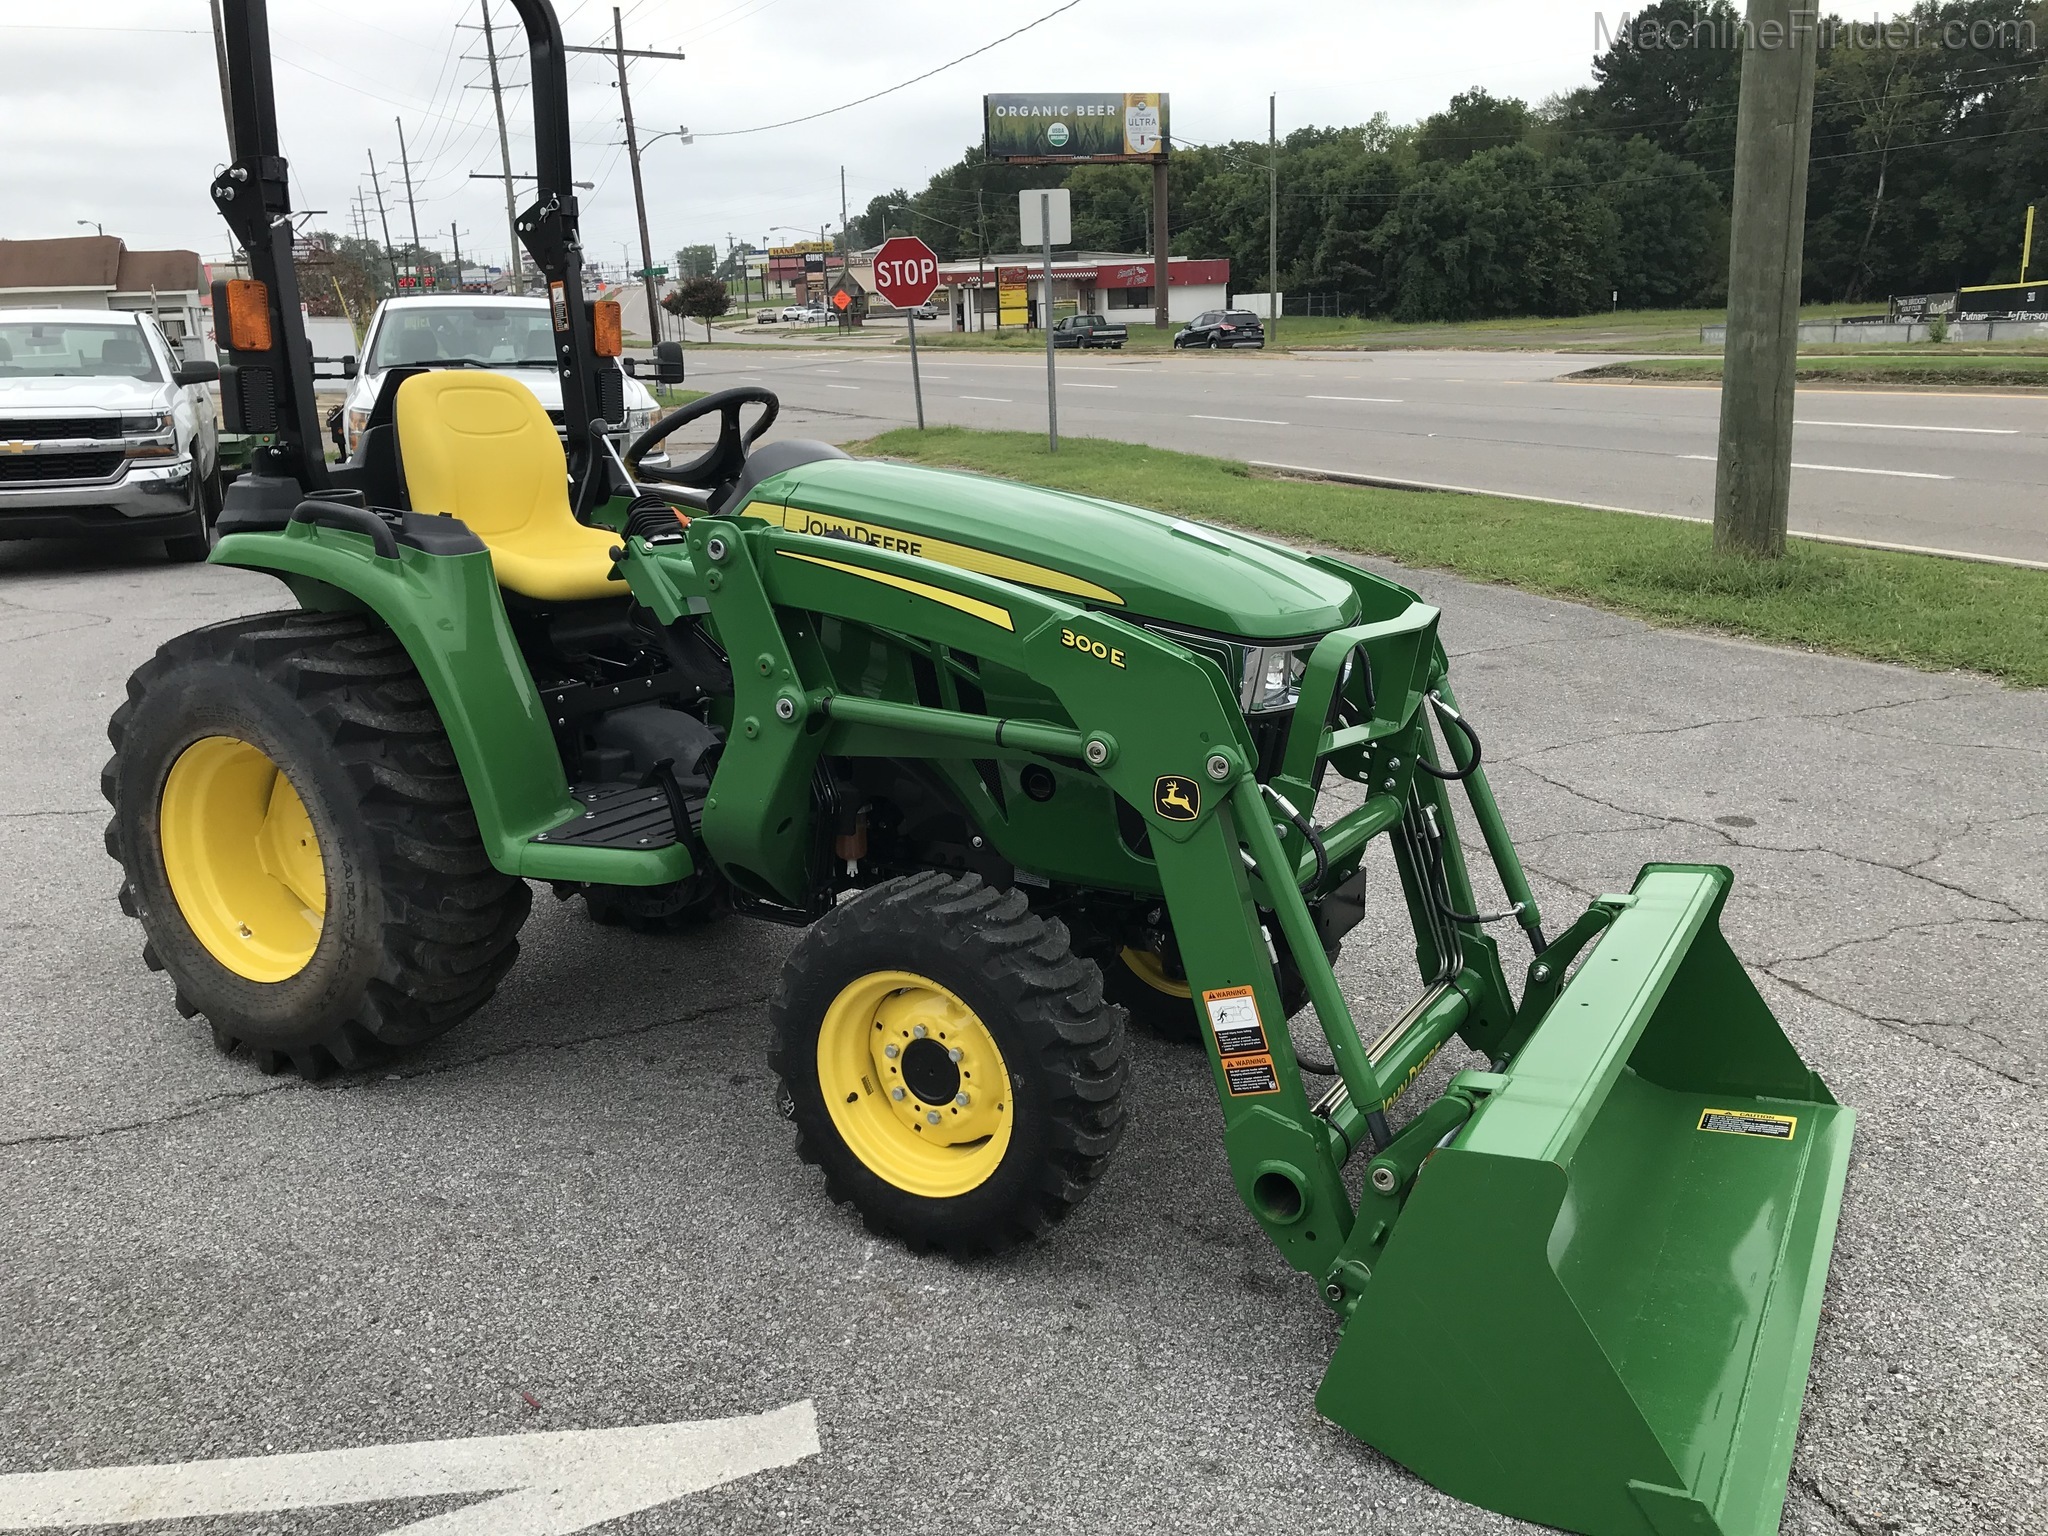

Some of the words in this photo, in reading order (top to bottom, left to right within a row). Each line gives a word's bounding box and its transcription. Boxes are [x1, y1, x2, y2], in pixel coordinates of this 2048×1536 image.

[996, 105, 1069, 117] ORGANIC
[1076, 105, 1116, 116] BEER
[1128, 118, 1157, 126] ULTRA
[805, 253, 824, 262] GUNS
[877, 258, 934, 287] STOP
[798, 515, 852, 540] JOHN
[855, 526, 923, 558] DEERE
[1061, 627, 1127, 670] 300E
[1215, 988, 1248, 998] WARNING
[1235, 1057, 1267, 1067] WARNING
[1739, 1112, 1776, 1120] CAUTION
